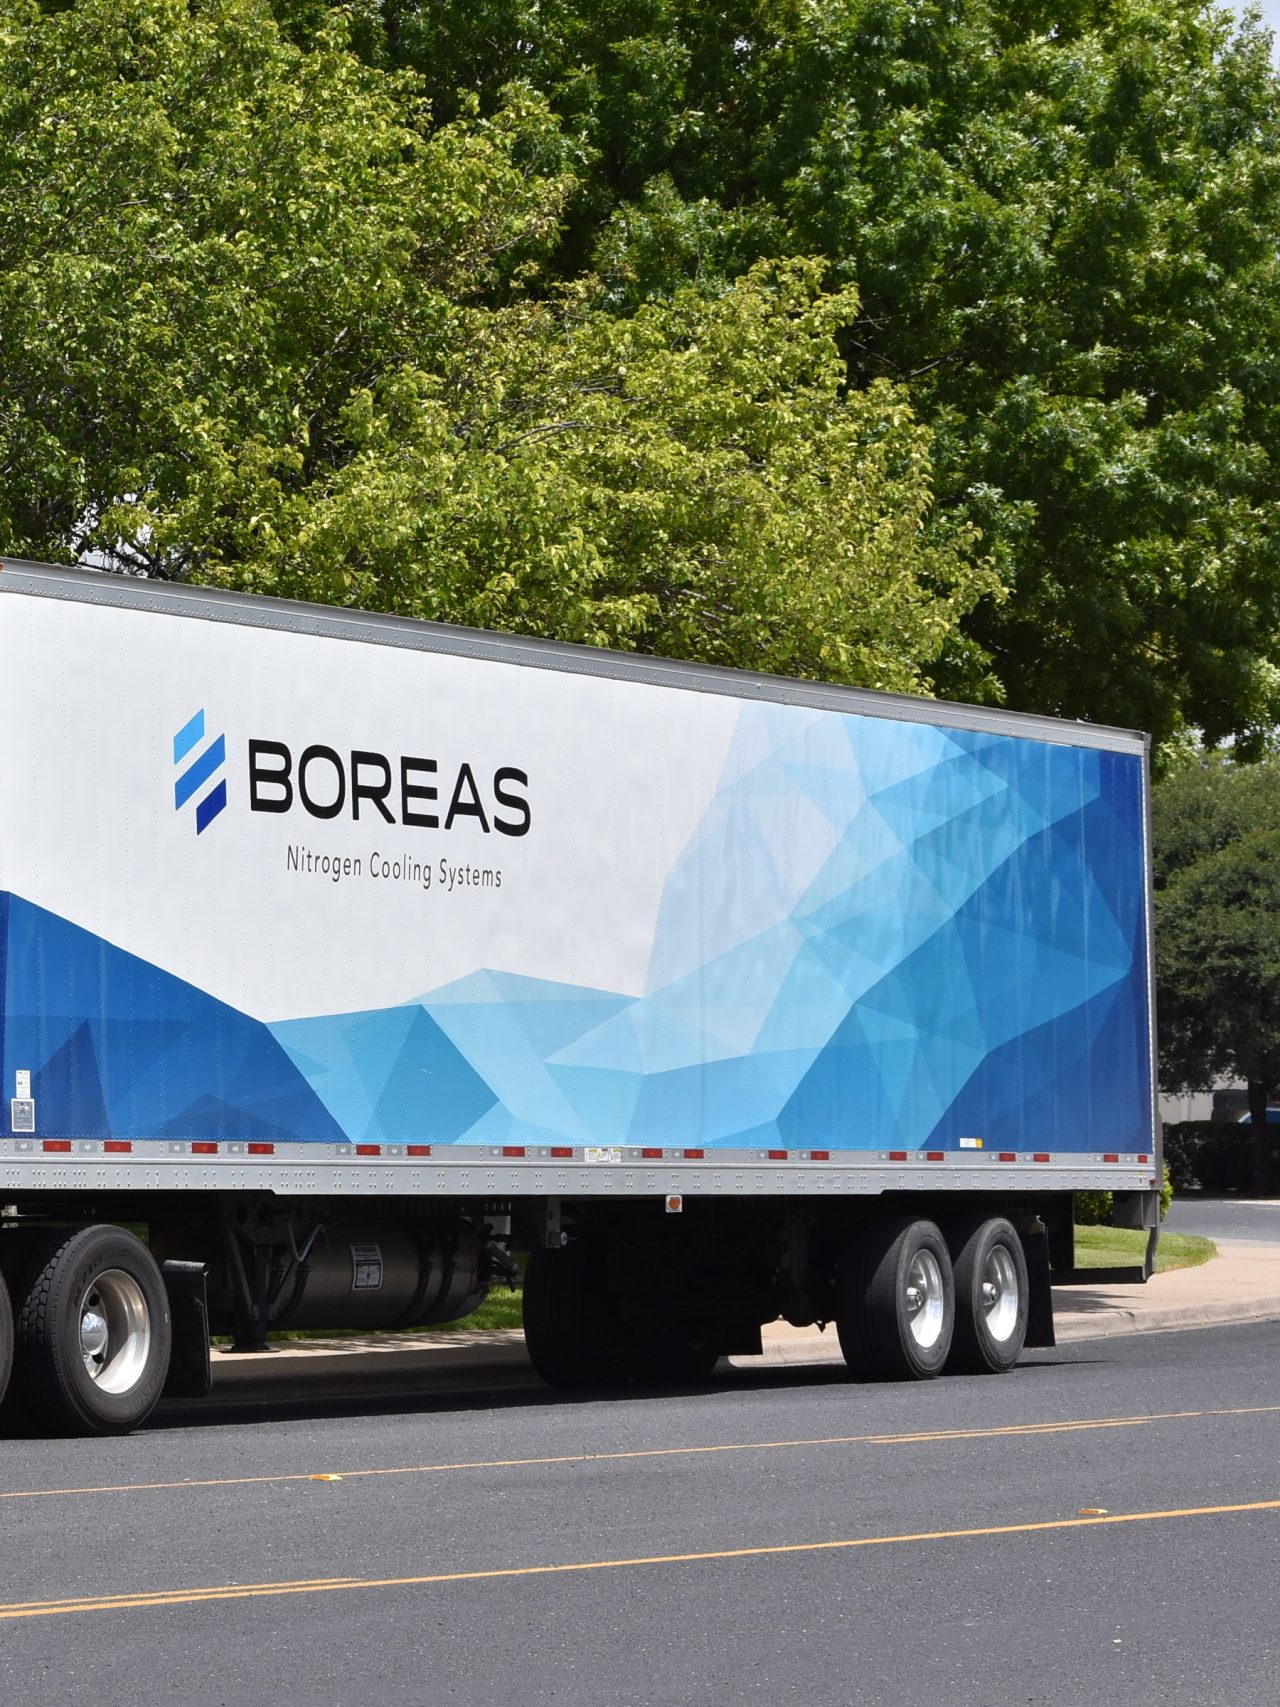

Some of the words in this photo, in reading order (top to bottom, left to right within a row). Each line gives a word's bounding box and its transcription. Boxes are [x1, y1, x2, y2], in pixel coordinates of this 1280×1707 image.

[248, 738, 531, 837] BOREAS
[287, 845, 362, 883] Nitrogen
[369, 852, 432, 890] Cooling
[439, 858, 502, 892] Systems
